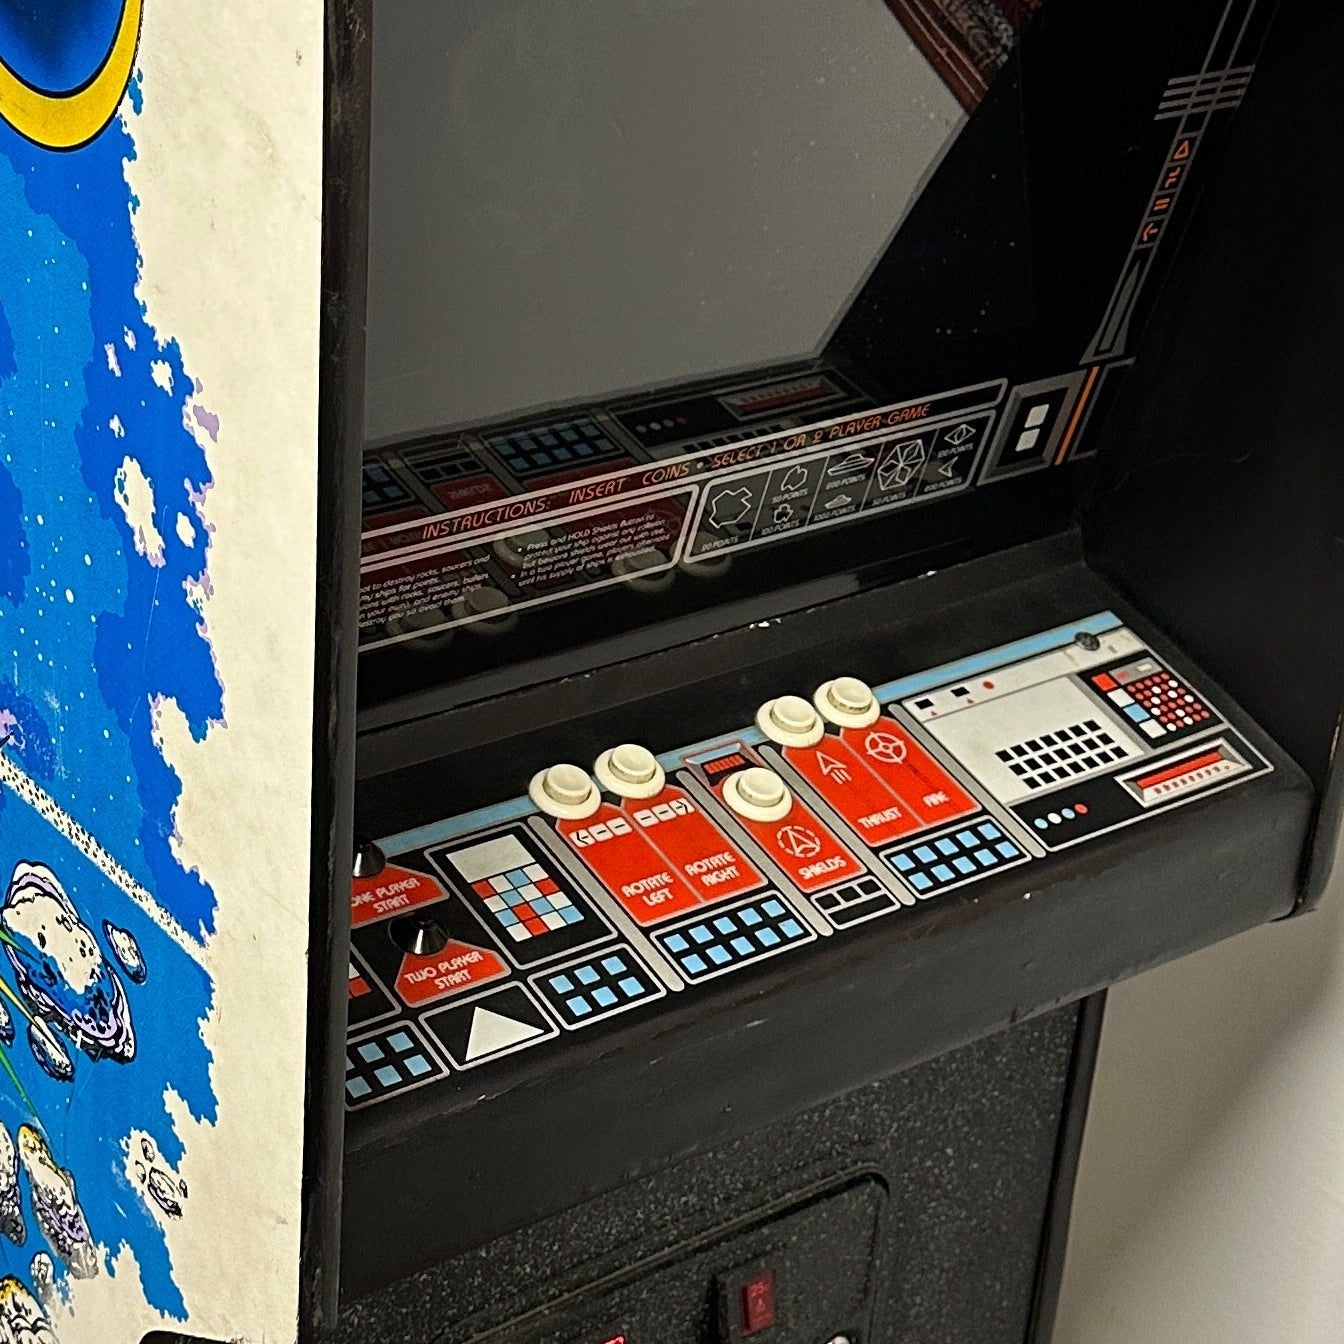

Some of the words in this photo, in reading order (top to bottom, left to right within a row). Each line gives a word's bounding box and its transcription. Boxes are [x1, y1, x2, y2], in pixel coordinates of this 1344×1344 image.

[421, 496, 552, 540] INSTRUCTIONS:
[568, 477, 628, 505] INSERT
[641, 461, 691, 487] COINS
[711, 444, 764, 469] SELECT
[782, 433, 806, 450] OR
[828, 414, 882, 440] PLAYER
[887, 402, 933, 425] GAME
[567, 529, 591, 541] HOLD
[382, 573, 416, 588] destroy
[473, 554, 491, 566] and
[397, 582, 413, 594] for
[921, 790, 950, 809] FIRE
[856, 806, 903, 829] THRUST
[684, 851, 737, 877] ROTATE
[700, 864, 741, 888] RIGHT
[797, 854, 848, 881] SHIELDS
[351, 891, 376, 908] ONE
[375, 877, 422, 899] PLAYER
[620, 871, 675, 898] ROTATE
[372, 893, 411, 914] START
[641, 887, 675, 907] LEFT
[403, 966, 438, 985] TWO
[437, 950, 484, 975] PLAYER
[433, 968, 473, 991] START
